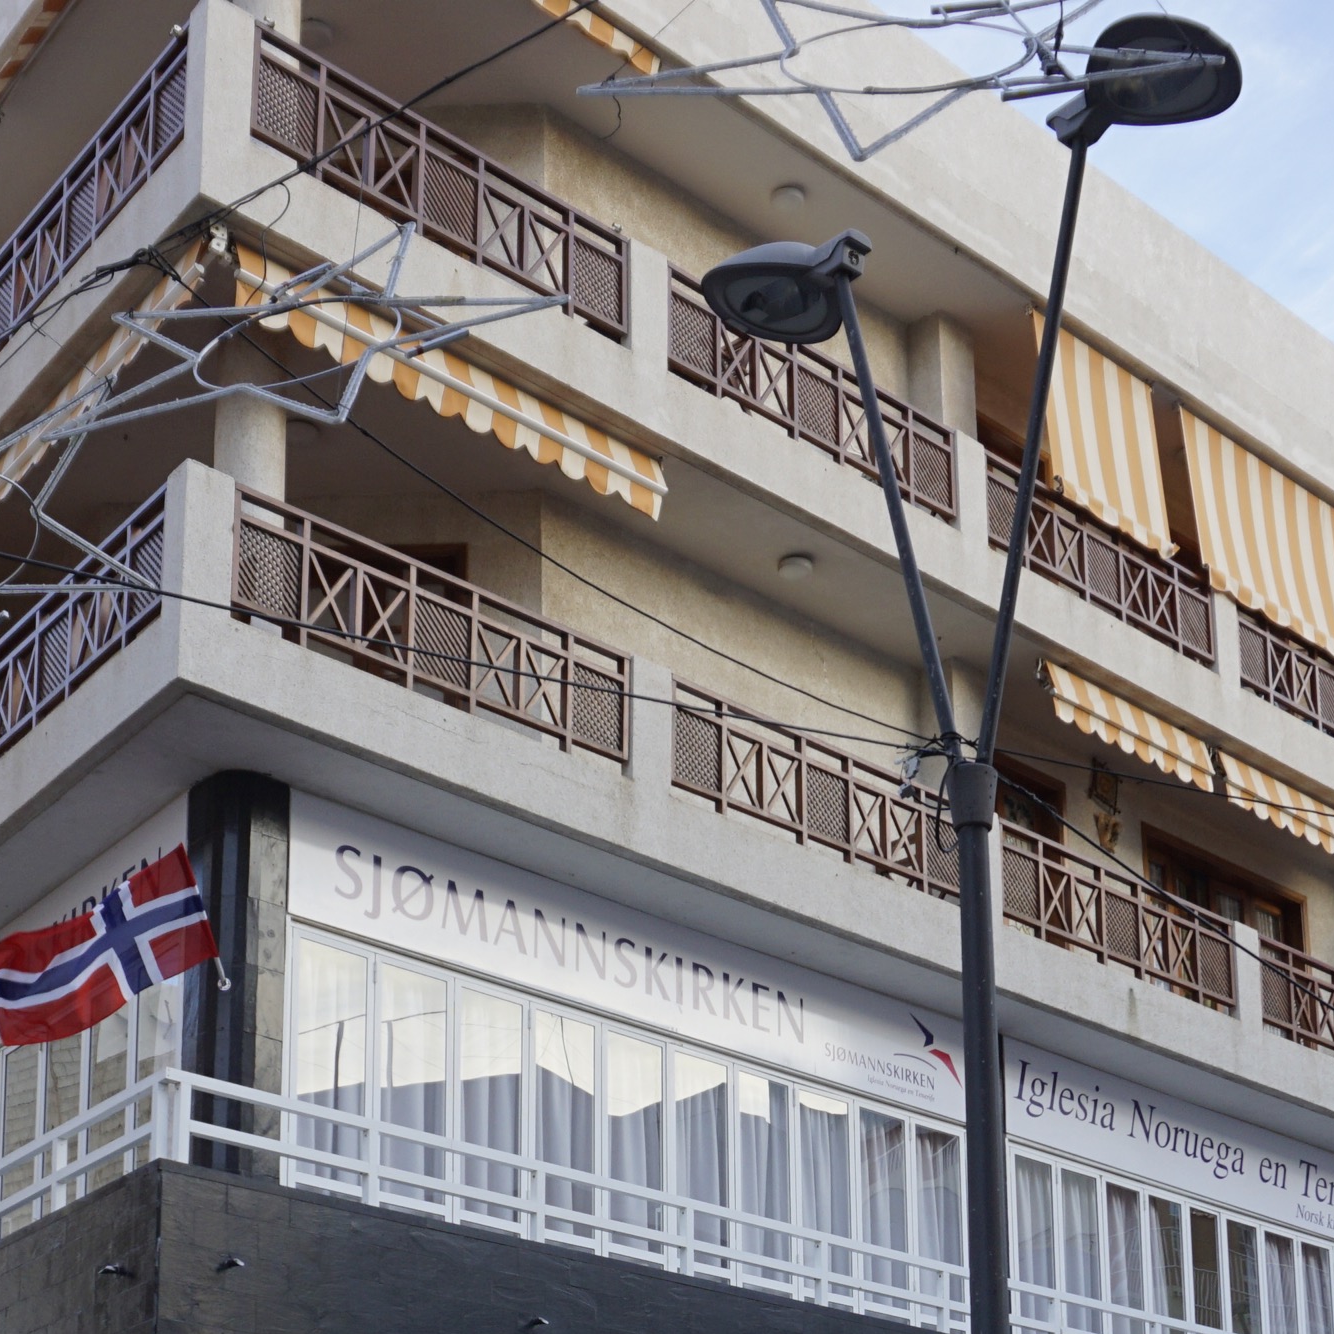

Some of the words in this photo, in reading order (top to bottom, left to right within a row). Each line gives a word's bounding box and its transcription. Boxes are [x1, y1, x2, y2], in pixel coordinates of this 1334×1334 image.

[333, 843, 805, 1044] SJØMANNSKIRKEN
[825, 1042, 935, 1091] SJØMANNSKIRKEN
[1013, 1059, 1116, 1132] Iglesia
[1127, 1099, 1245, 1180] Noruega
[1259, 1157, 1287, 1191] en
[1295, 1203, 1324, 1228] Norsk
